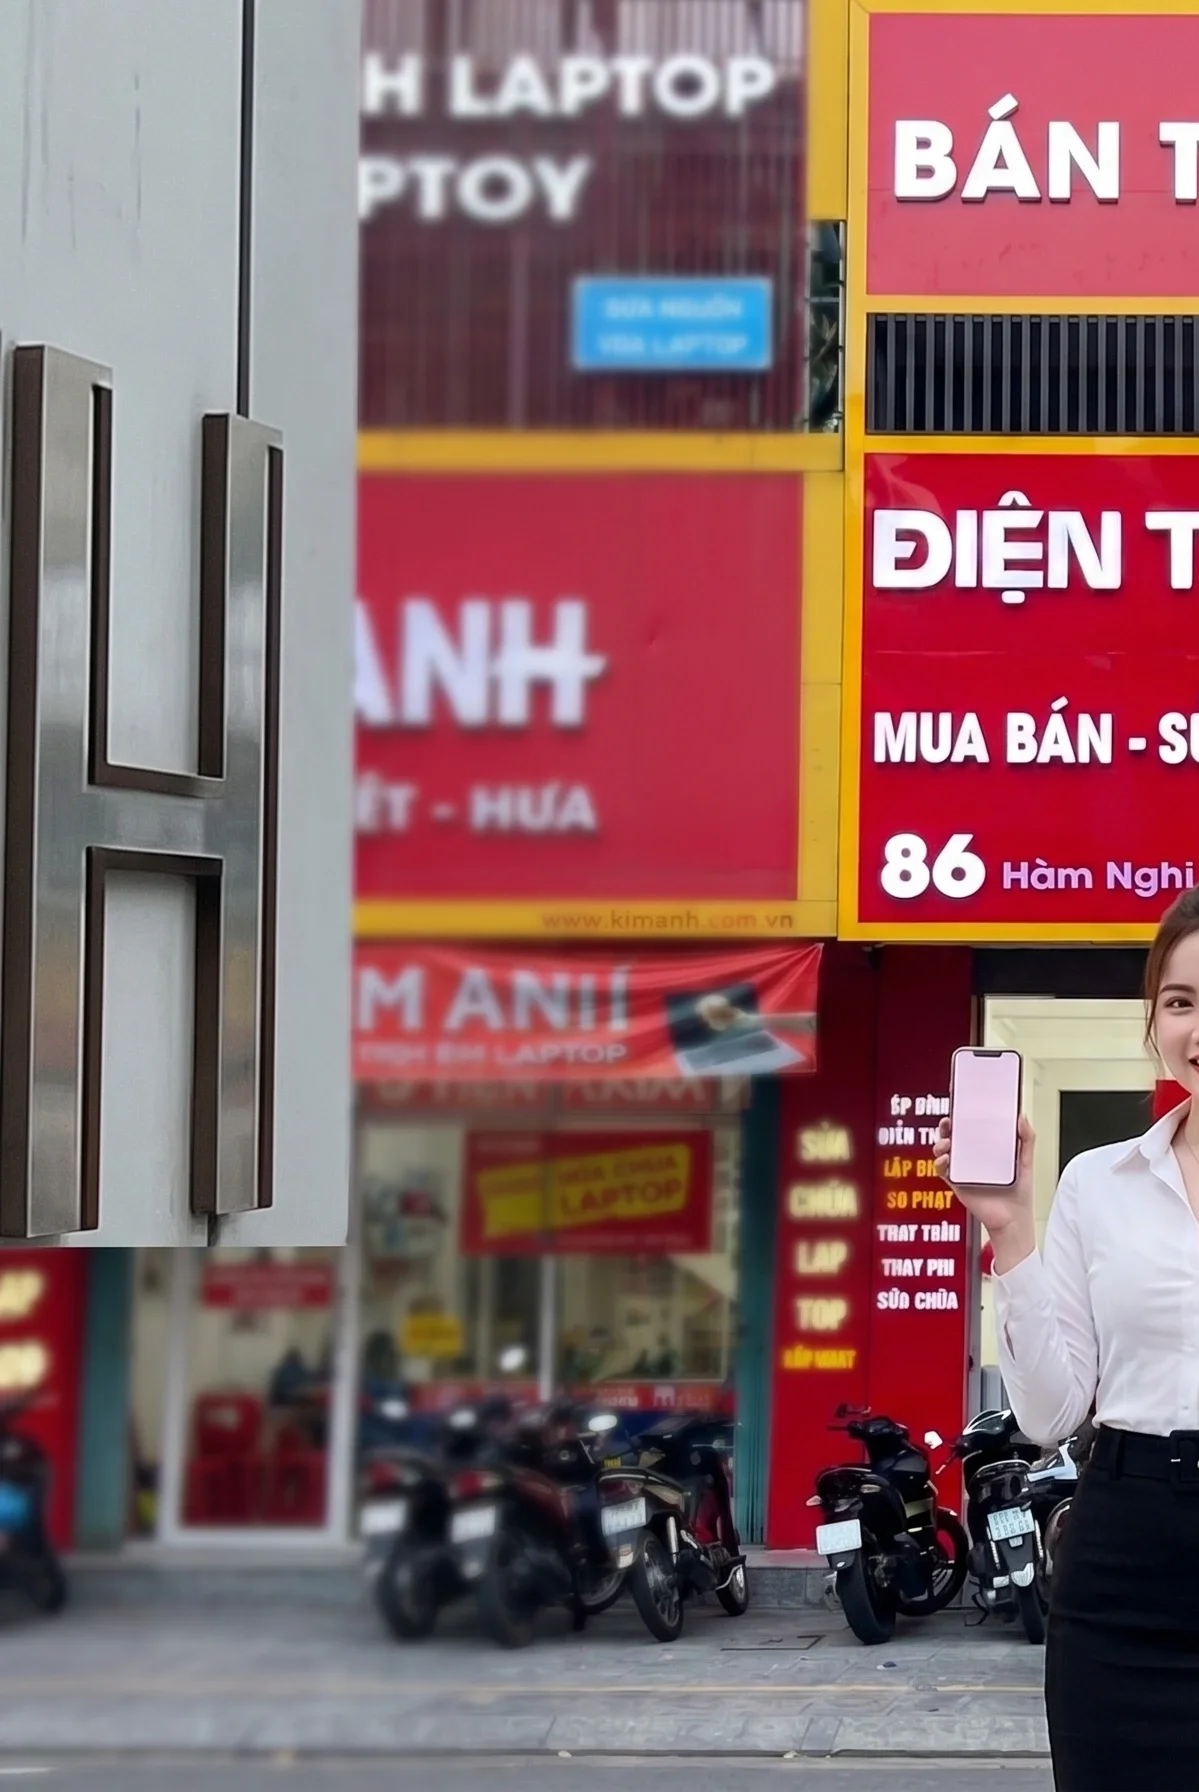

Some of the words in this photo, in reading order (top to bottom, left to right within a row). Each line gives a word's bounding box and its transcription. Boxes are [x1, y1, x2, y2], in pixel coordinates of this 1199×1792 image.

[448, 55, 775, 117] LAPTOP
[894, 92, 1120, 202] BÁN
[872, 490, 1122, 605] ĐIỆN
[874, 712, 990, 764] MUA
[1007, 698, 1113, 764] BÁN
[1129, 735, 1147, 751] -
[880, 834, 986, 899] 86
[1003, 863, 1092, 889] Hàm
[1106, 862, 1194, 896] Nghi
[494, 1043, 627, 1064] LAPTOP
